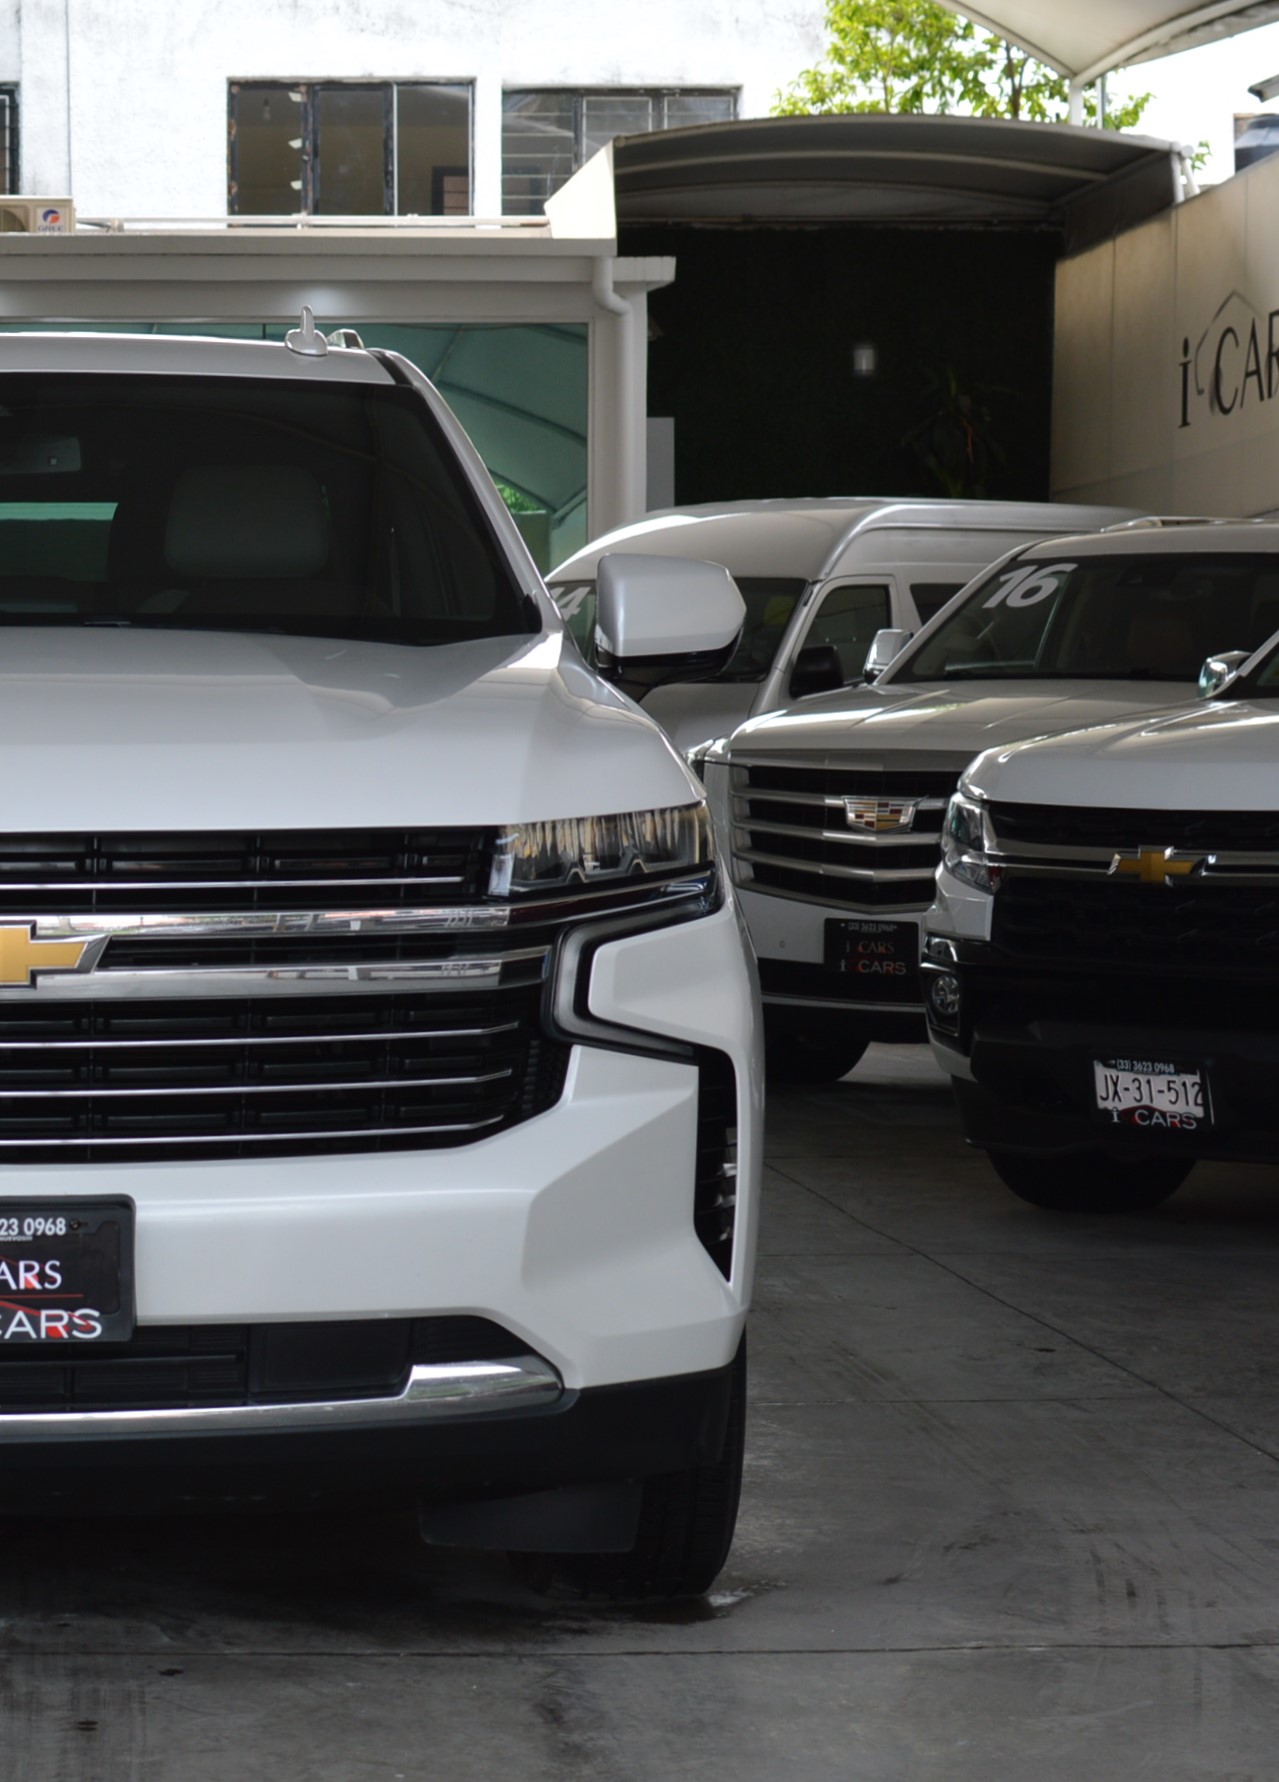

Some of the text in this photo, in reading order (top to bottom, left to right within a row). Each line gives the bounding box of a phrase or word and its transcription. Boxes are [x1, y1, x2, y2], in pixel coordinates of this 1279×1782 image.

[982, 563, 1079, 609] 16
[859, 940, 894, 954] CARS
[858, 960, 907, 976] CARS
[1116, 1059, 1132, 1071] (33)
[1133, 1060, 1153, 1072] 3623
[1154, 1062, 1175, 1074] 0968
[1099, 1073, 1204, 1107] JX-31-512
[1134, 1109, 1198, 1130] CARS
[23, 1216, 67, 1236] 0968
